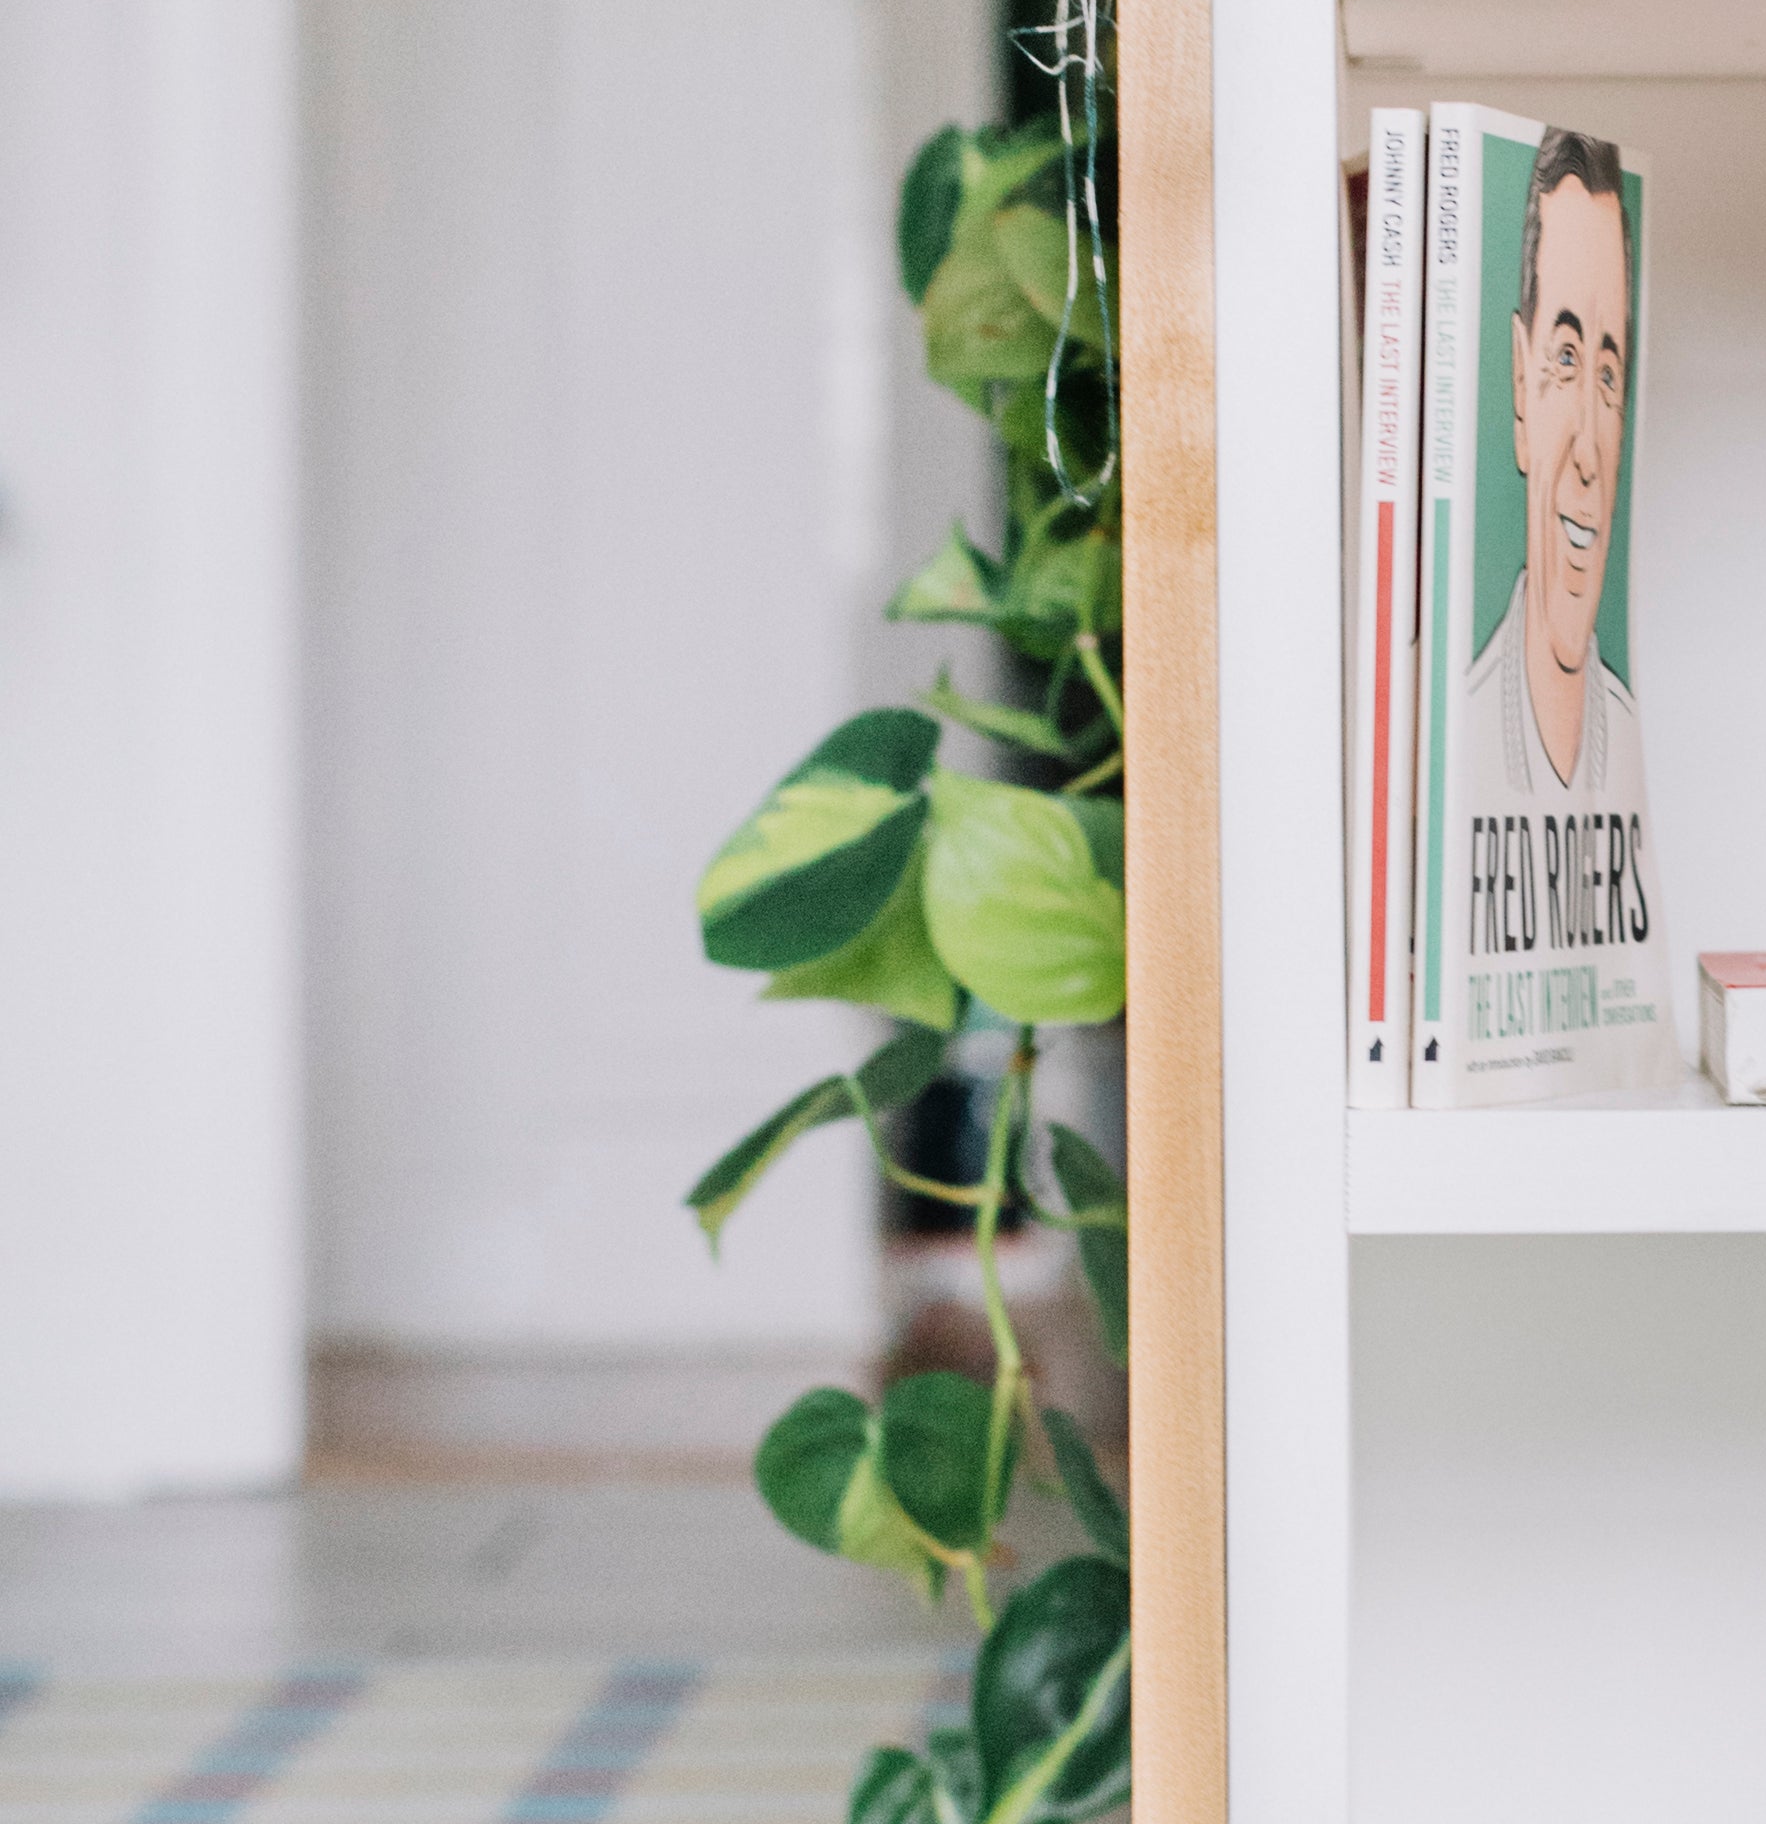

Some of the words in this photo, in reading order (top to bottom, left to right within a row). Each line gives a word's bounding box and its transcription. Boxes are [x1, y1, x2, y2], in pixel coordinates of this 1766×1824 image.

[1383, 129, 1406, 210] JOHNNY
[1439, 127, 1460, 178] FRED
[1382, 214, 1405, 267] CASH
[1437, 186, 1459, 265] ROGERS
[1380, 280, 1402, 313] THE
[1437, 278, 1457, 313] THE
[1379, 323, 1401, 370] LAST
[1435, 321, 1457, 367] LAST
[1377, 379, 1400, 487] INTERVIEW
[1434, 376, 1455, 485] INTERVIEW
[1470, 815, 1536, 956] FRED
[1544, 813, 1649, 950] ROGERS
